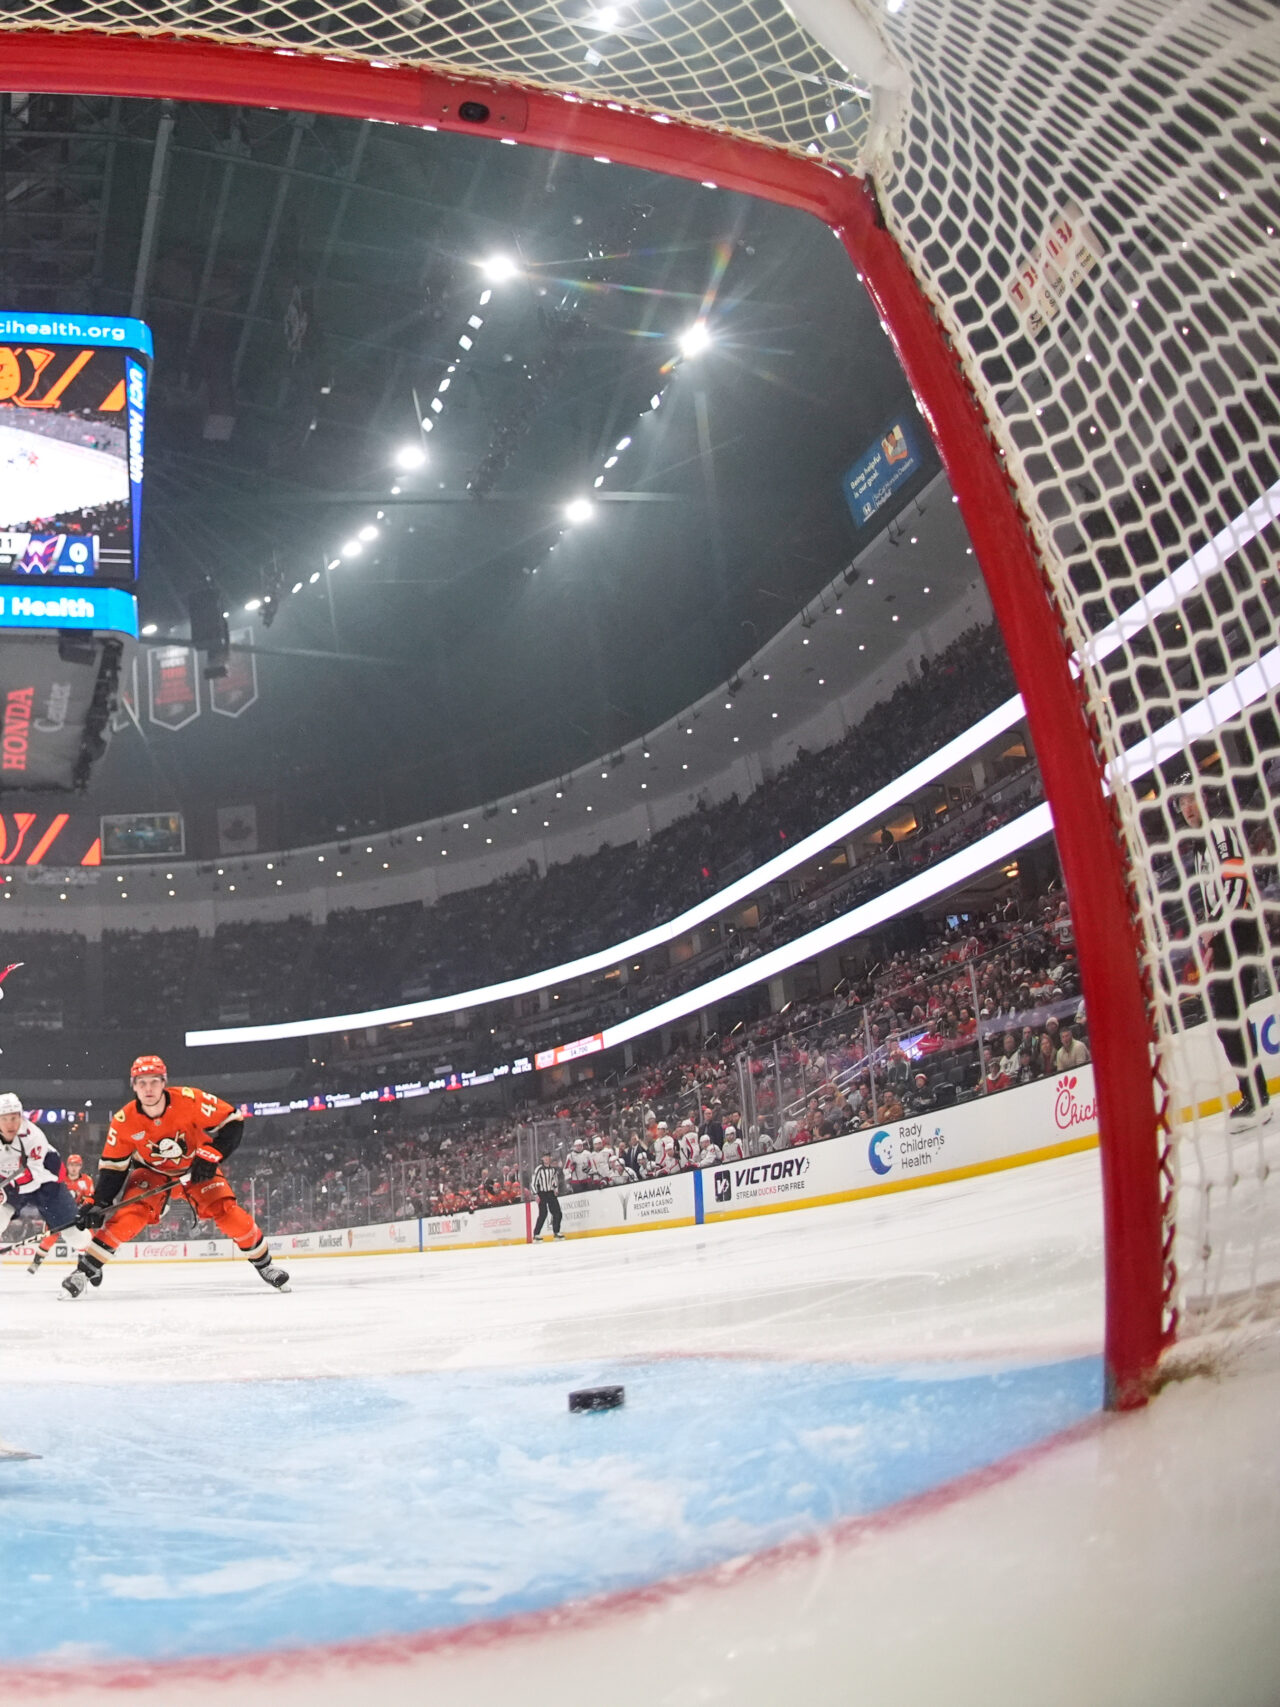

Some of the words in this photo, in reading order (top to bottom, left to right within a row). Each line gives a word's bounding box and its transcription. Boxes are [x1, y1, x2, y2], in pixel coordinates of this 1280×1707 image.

[129, 367, 143, 409] UCI
[69, 543, 88, 563] 0
[12, 597, 94, 618] Health
[2, 686, 35, 771] HONDA
[33, 675, 71, 733] Center
[200, 1091, 219, 1118] 45
[106, 1127, 118, 1147] 5
[899, 1123, 922, 1139] Rady
[901, 1153, 932, 1169] Health
[200, 1180, 225, 1194] CCM
[736, 1190, 758, 1200] STREAM
[758, 1185, 777, 1196] DUCKS
[777, 1182, 790, 1193] FOR
[790, 1180, 805, 1190] FREE
[633, 1202, 651, 1211] RESORT
[655, 1198, 673, 1207] CASINO
[640, 1209, 650, 1218] SAN
[651, 1206, 670, 1216] MANUEL
[143, 1242, 179, 1257] Coca-Cola
[319, 1235, 342, 1249] Kwikset
